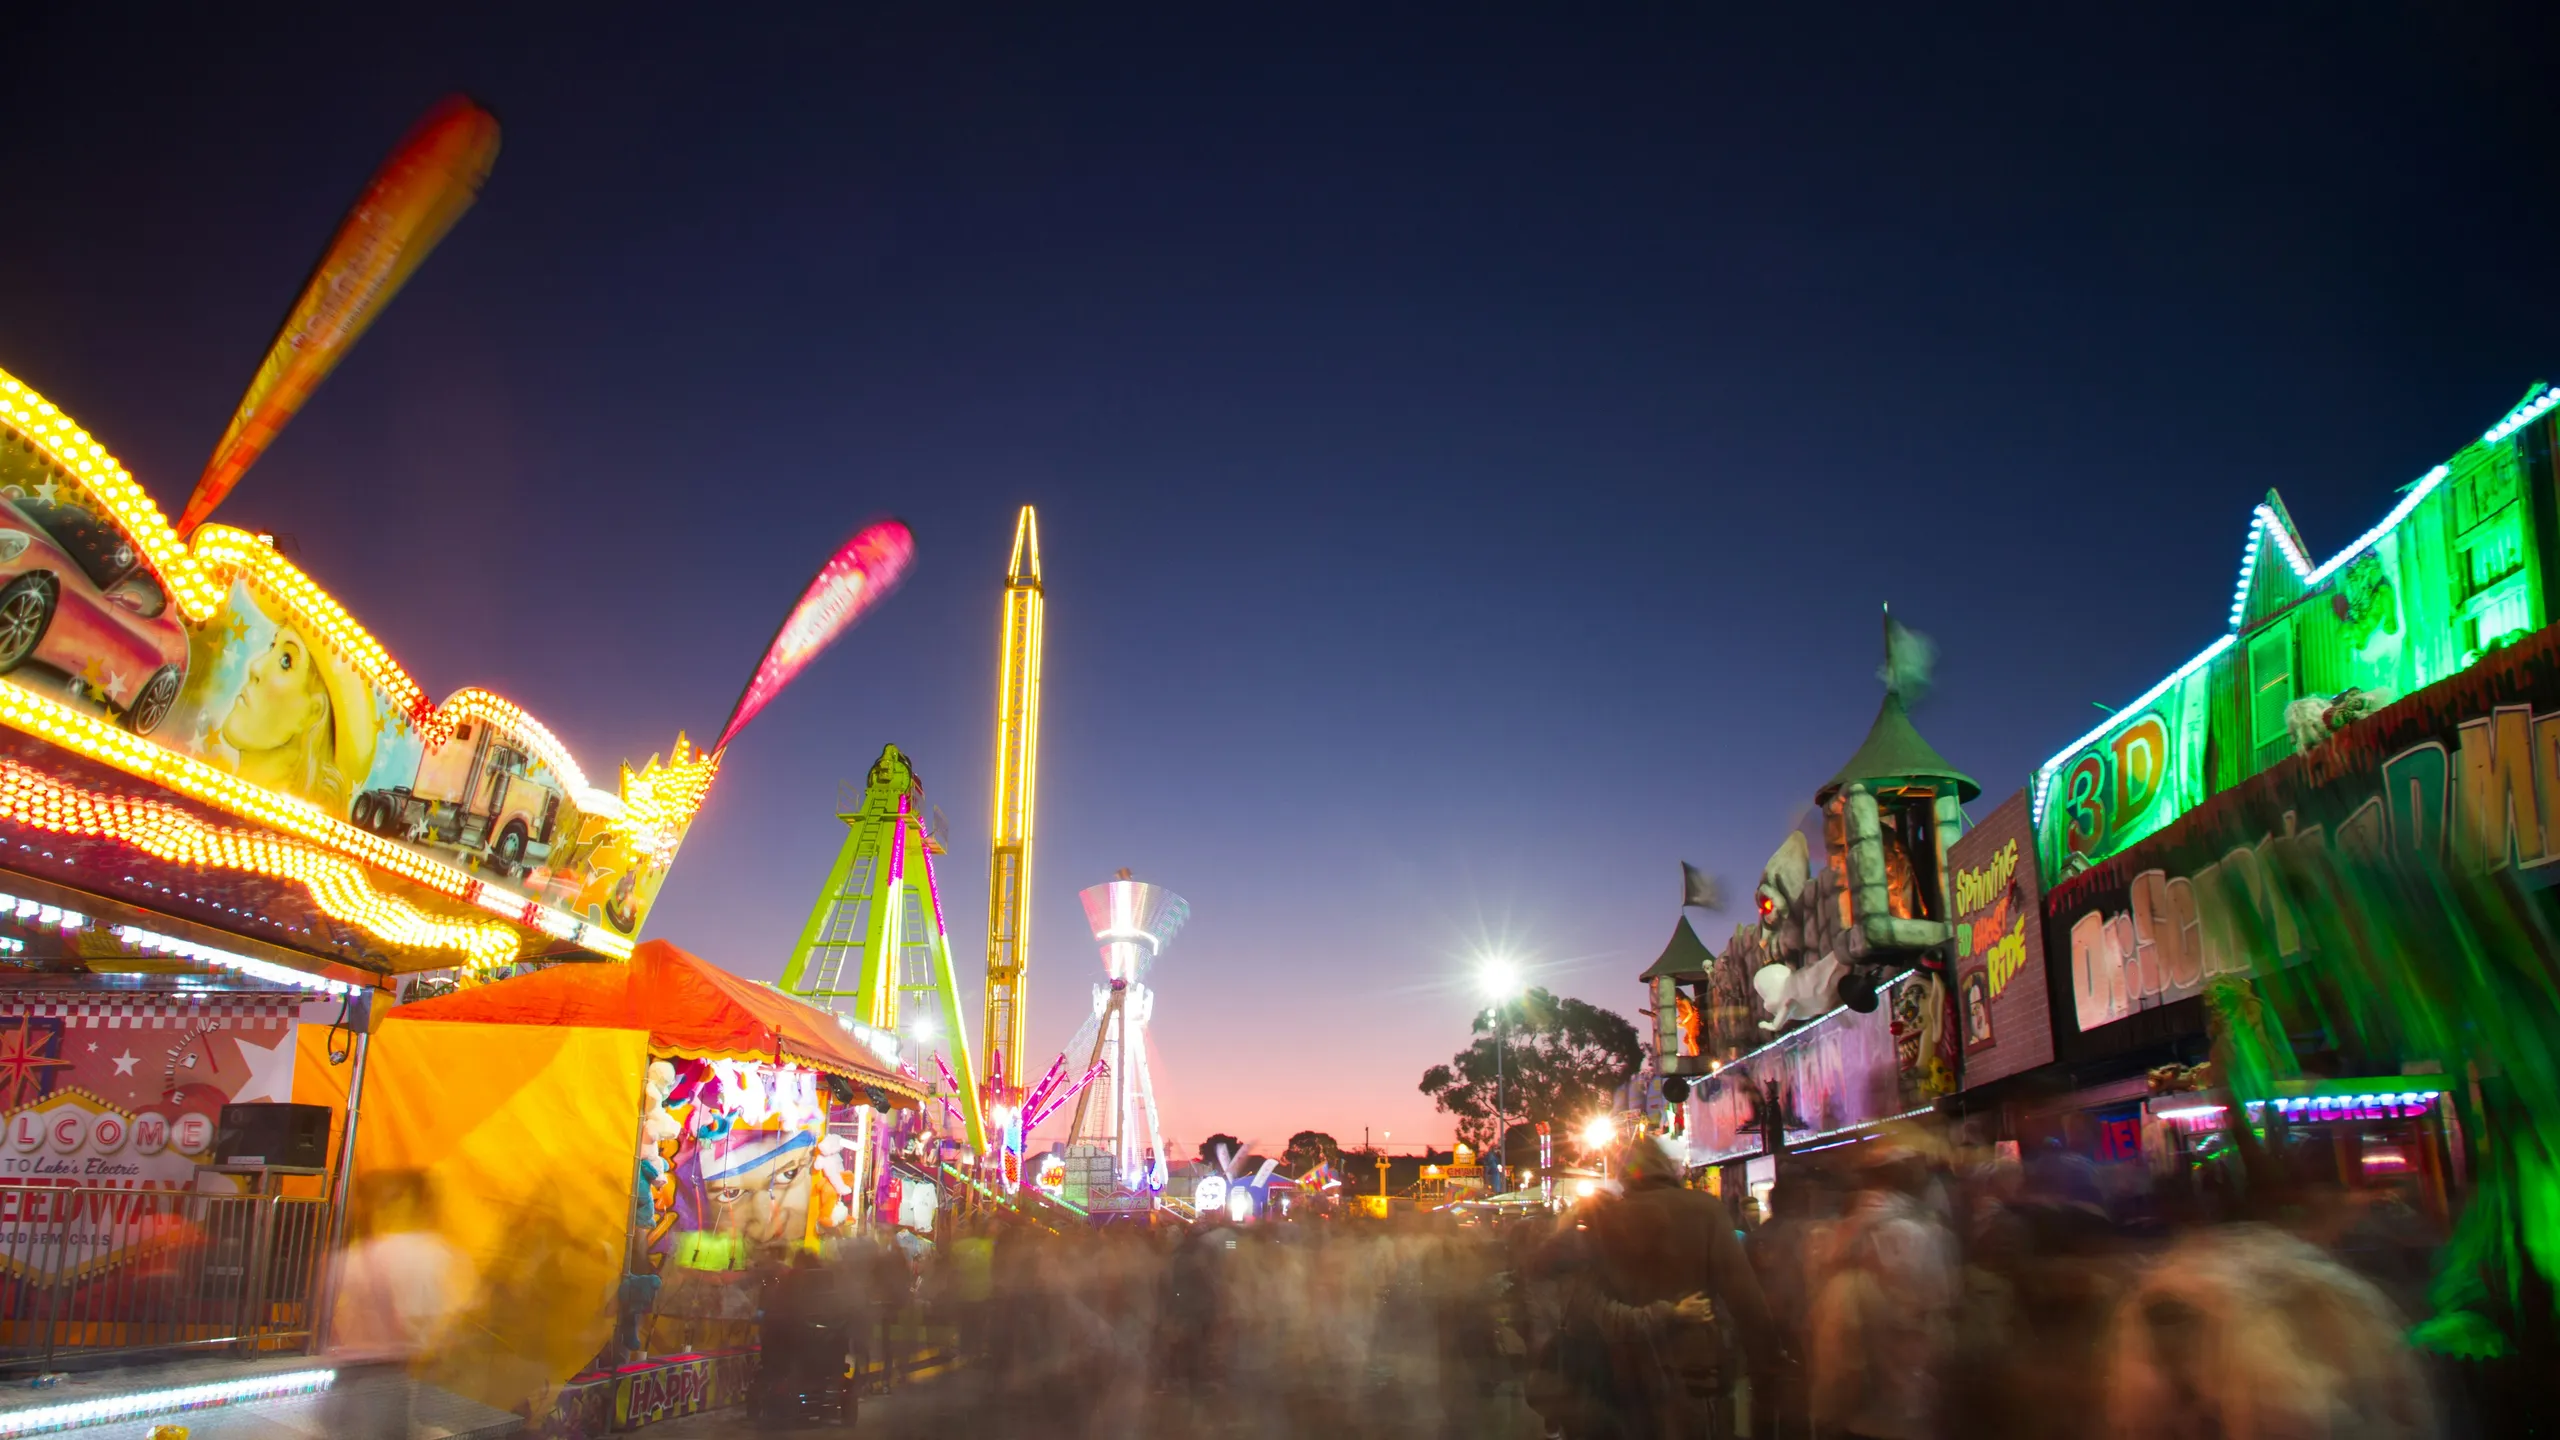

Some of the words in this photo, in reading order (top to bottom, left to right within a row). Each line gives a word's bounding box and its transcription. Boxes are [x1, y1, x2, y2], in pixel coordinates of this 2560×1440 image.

[2067, 712, 2172, 856] 3D
[5, 1158, 31, 1173] TO
[33, 1156, 80, 1174] Luke's
[85, 1157, 140, 1176] Electric
[629, 1364, 710, 1419] HAPPY
